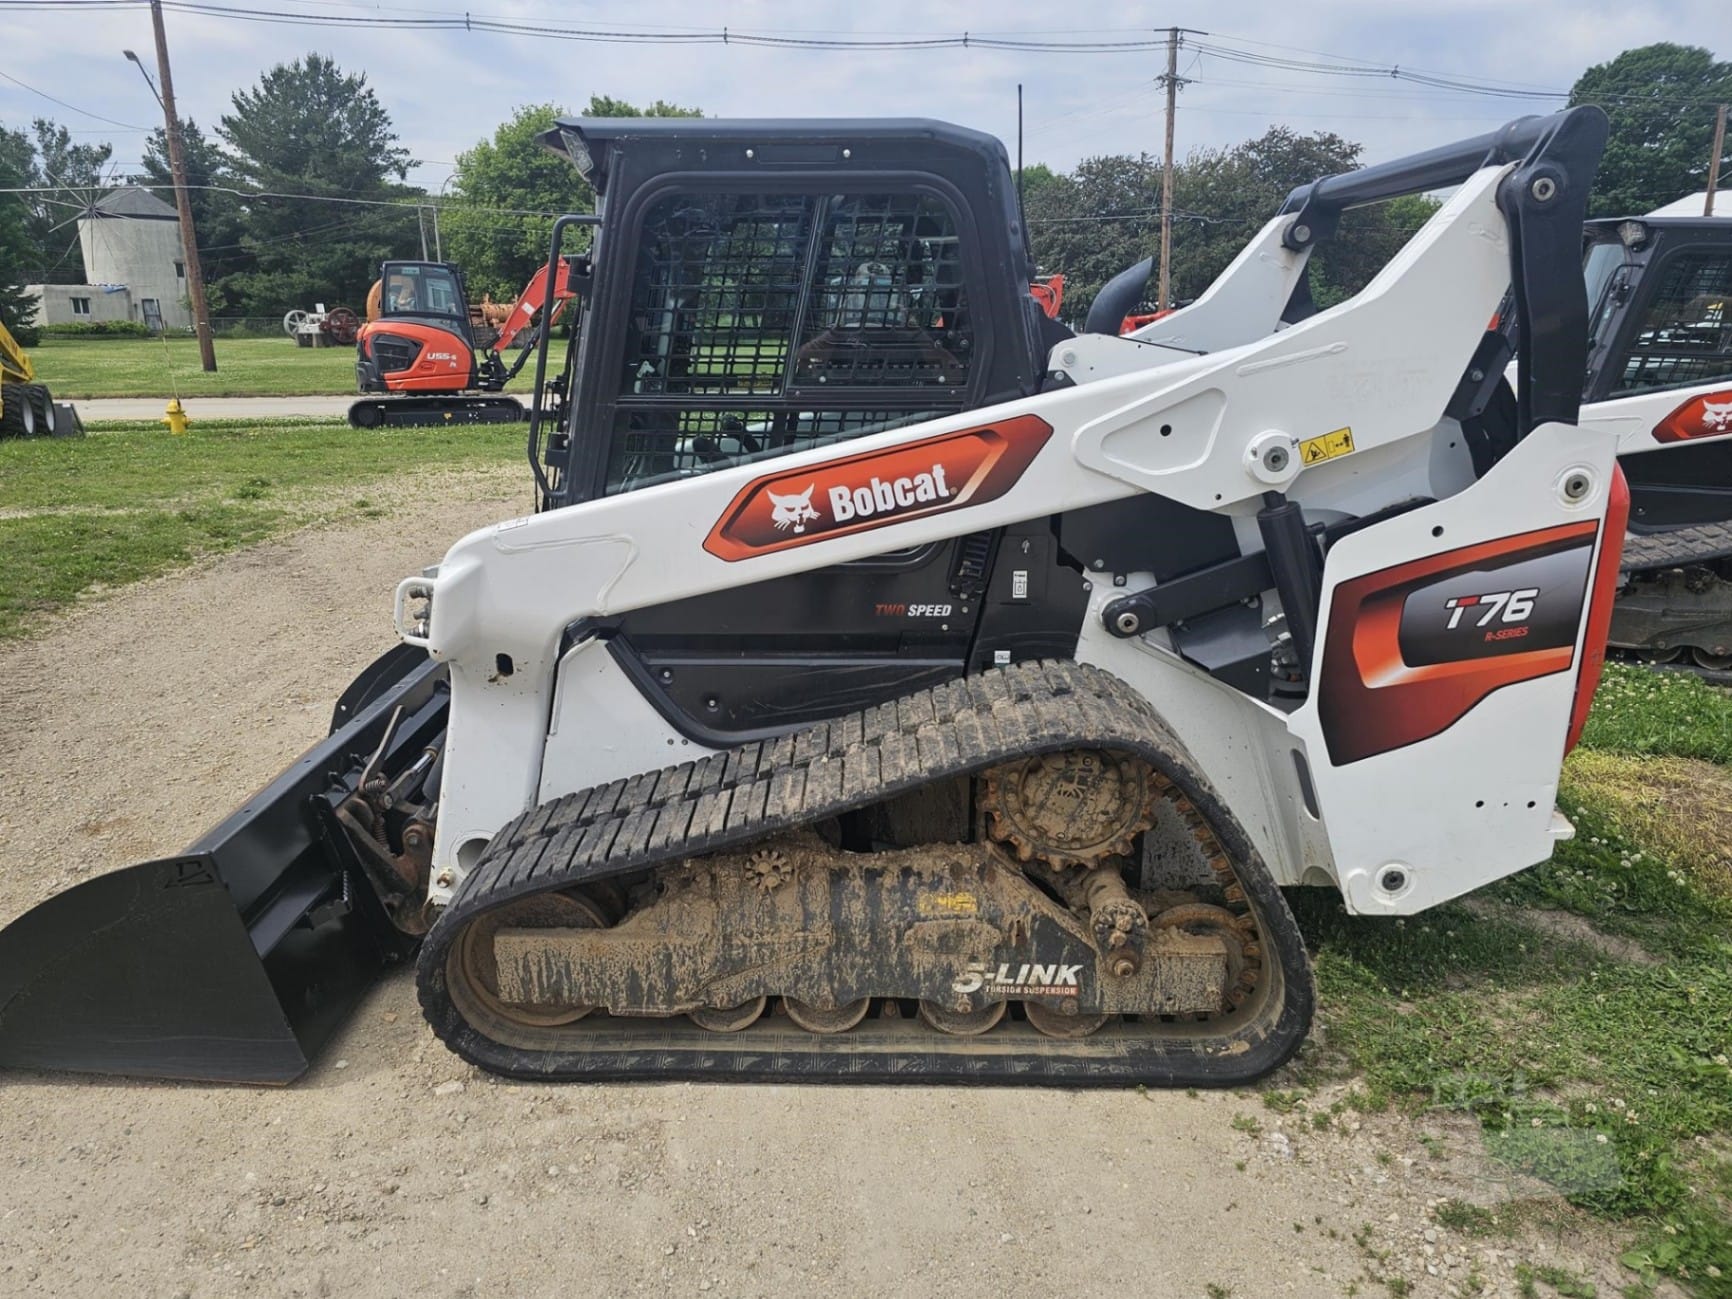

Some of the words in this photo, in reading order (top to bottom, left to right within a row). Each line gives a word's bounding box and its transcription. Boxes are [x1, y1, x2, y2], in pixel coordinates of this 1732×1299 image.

[828, 464, 949, 522] Bobcat
[875, 604, 906, 616] TWO
[907, 603, 952, 617] SPEED
[1445, 587, 1540, 630] T76
[1484, 626, 1529, 642] R-SERIES
[951, 962, 1084, 993] 5-LINK
[985, 985, 1021, 993] TORSION
[1023, 986, 1076, 995] SUSPENSION
